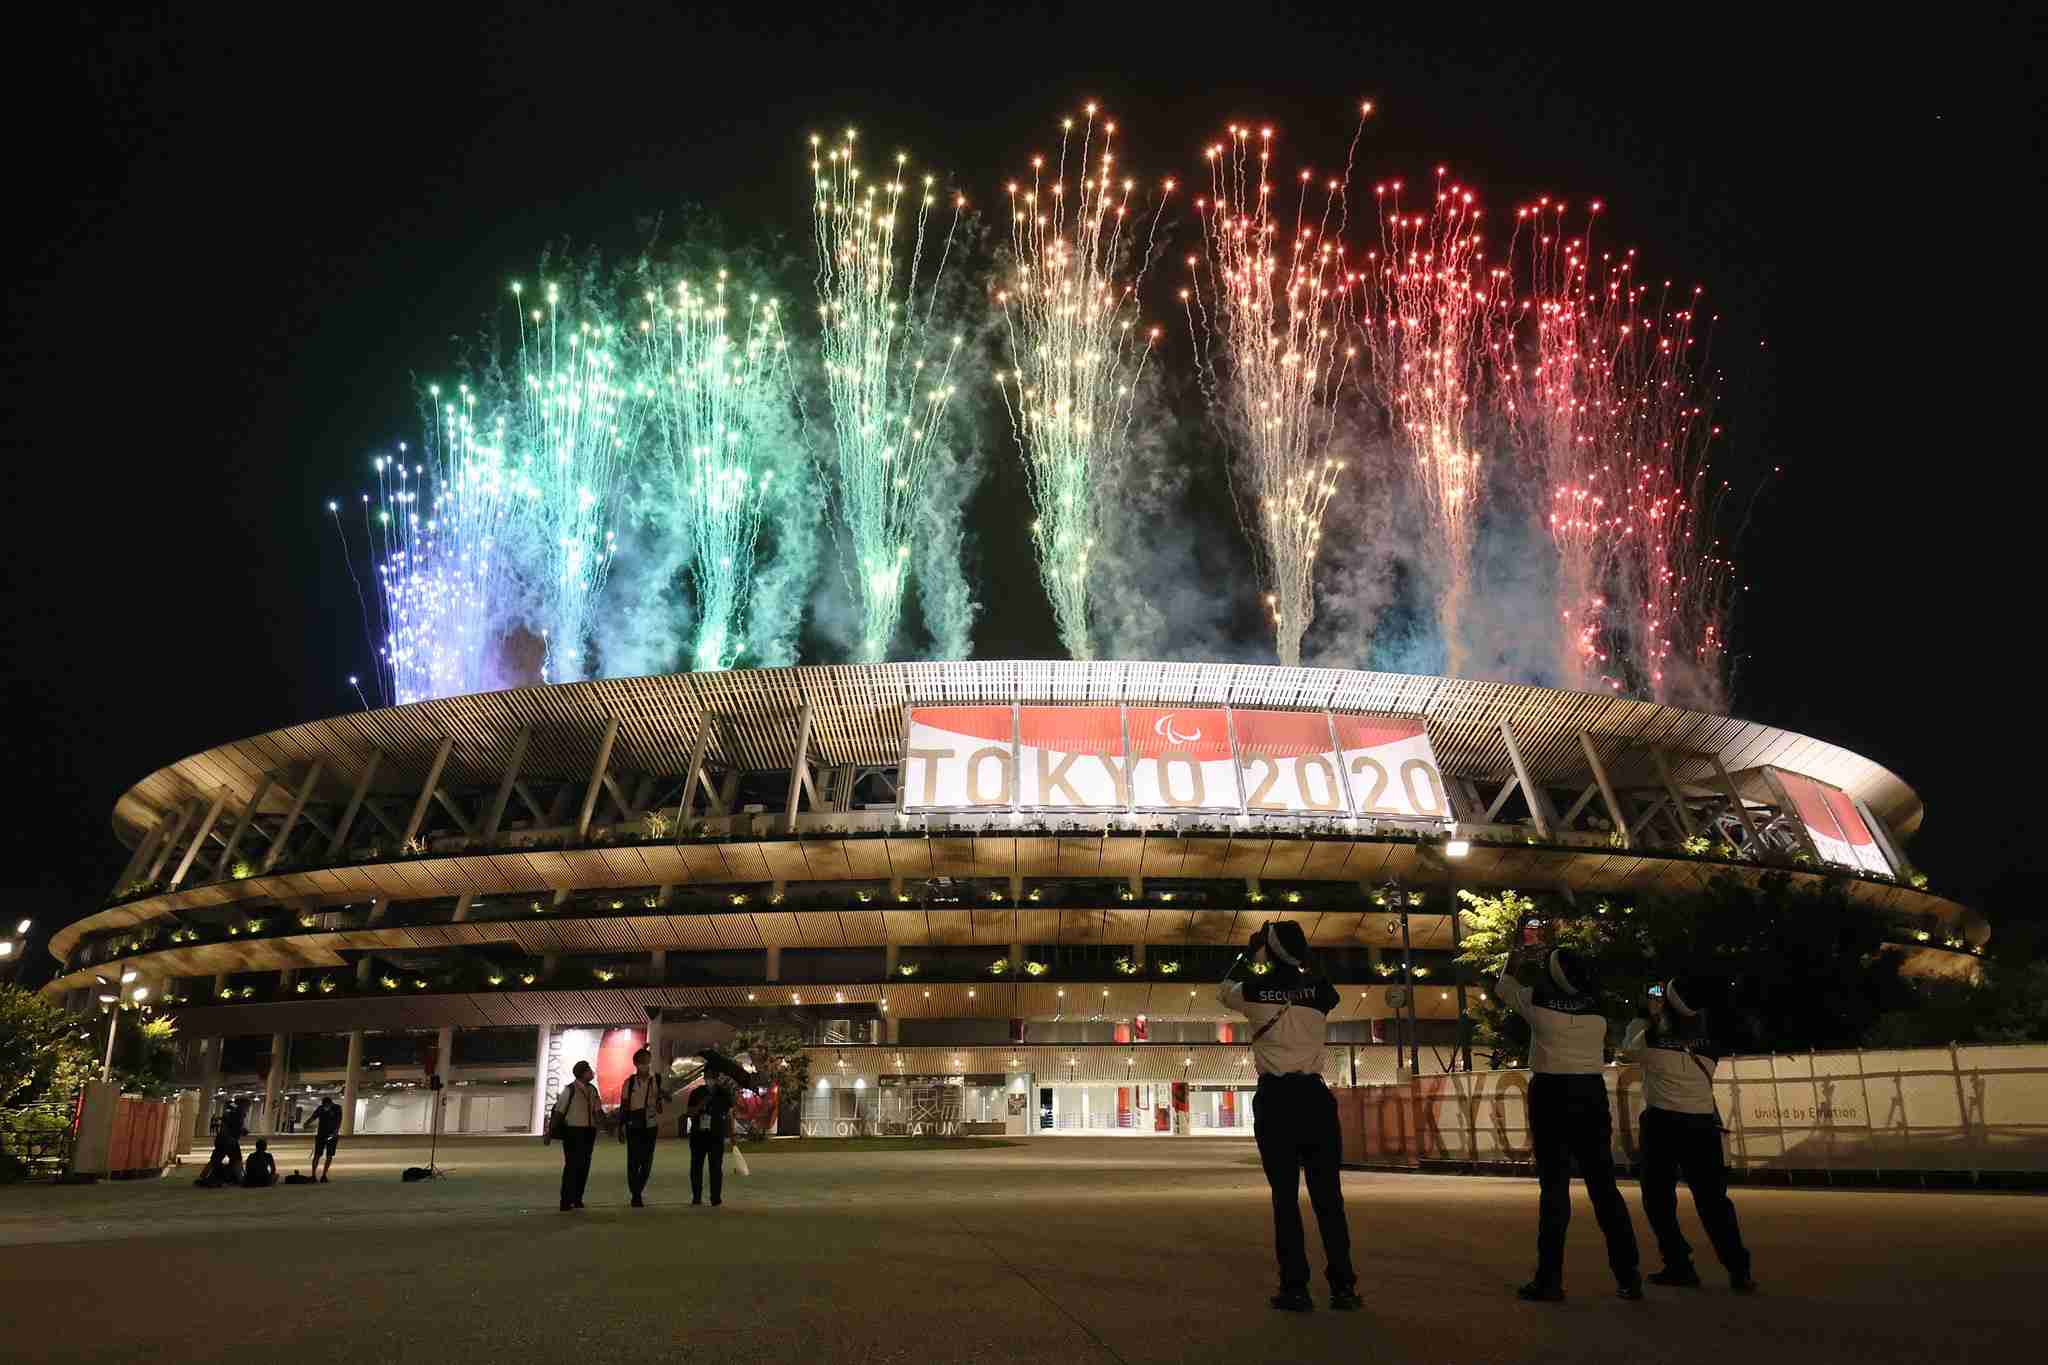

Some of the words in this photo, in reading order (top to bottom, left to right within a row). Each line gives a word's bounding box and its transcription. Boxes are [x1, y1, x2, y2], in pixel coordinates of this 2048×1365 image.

[910, 747, 1206, 808] TOKYO
[1244, 752, 1447, 817] 2020
[1259, 985, 1317, 1001] SECURITY
[1754, 1105, 1790, 1120] United
[1792, 1105, 1806, 1121] by
[800, 1119, 884, 1137] NATIONAL
[897, 1119, 961, 1137] TADIUM
